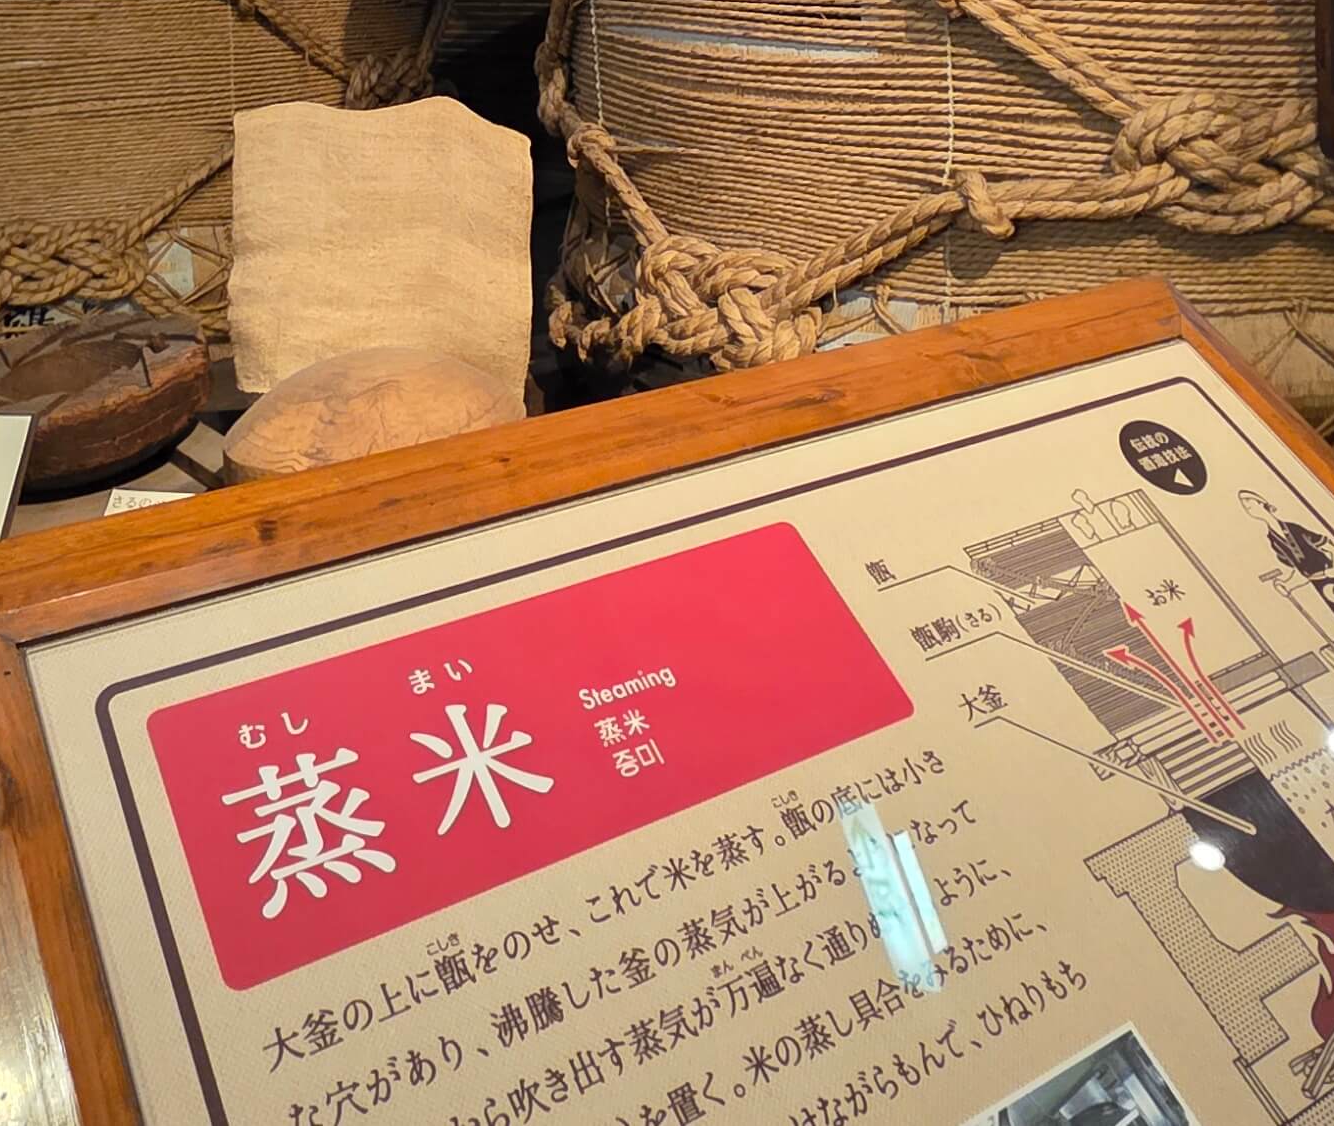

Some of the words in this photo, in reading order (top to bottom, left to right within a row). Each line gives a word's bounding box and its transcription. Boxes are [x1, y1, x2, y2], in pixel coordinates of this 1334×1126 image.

[1145, 578, 1186, 607] お米
[238, 711, 309, 750] むし
[407, 657, 474, 695] まい
[578, 666, 677, 711] Steaming
[957, 683, 1008, 722] 大釜
[593, 708, 651, 749] 蒸米
[612, 738, 666, 778] 증미
[221, 702, 556, 921] 蒸米
